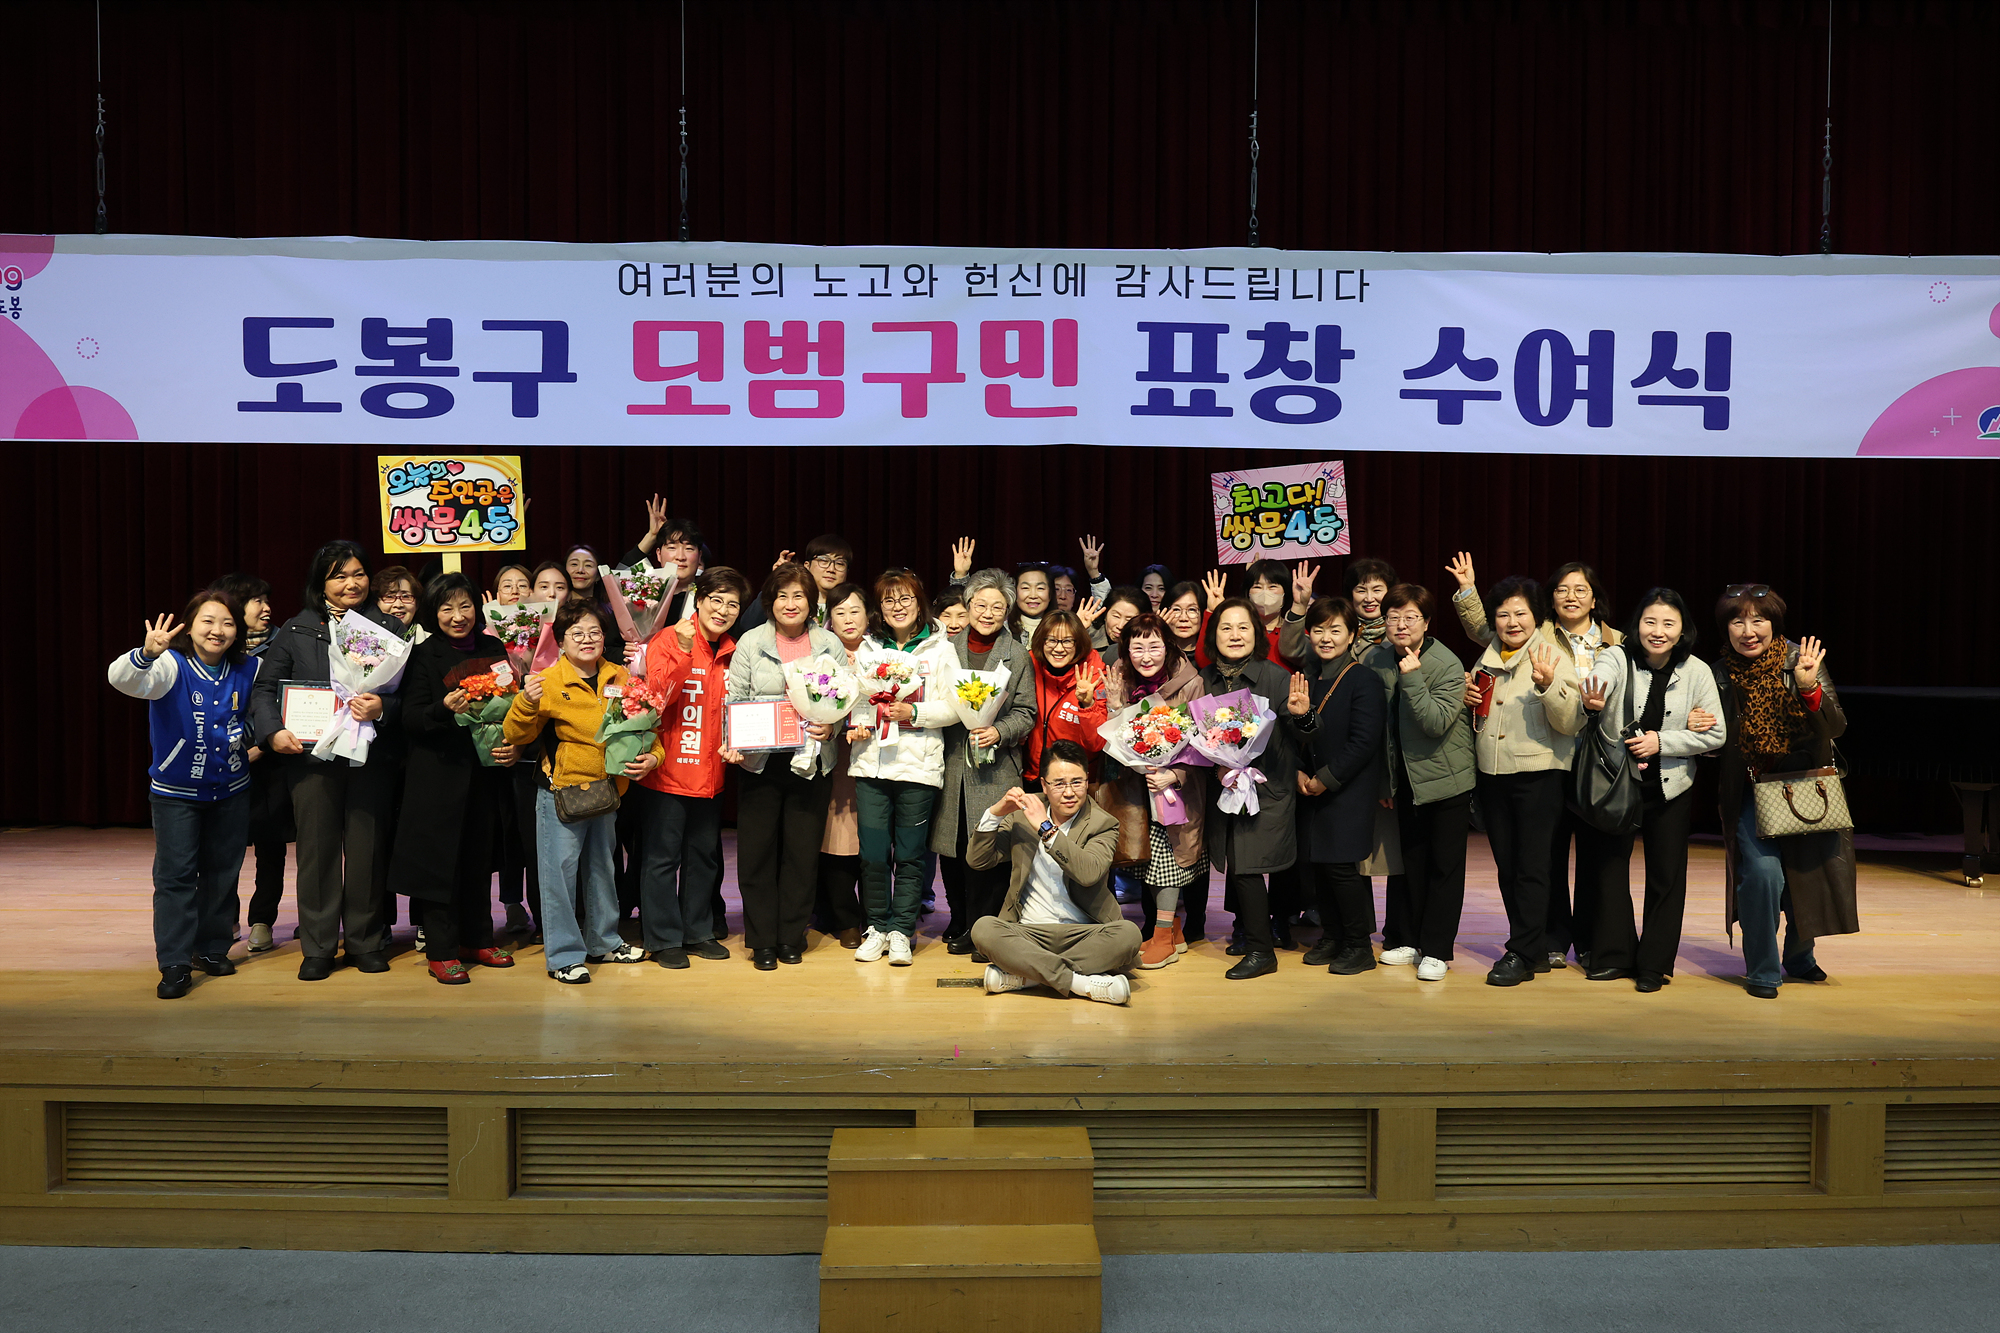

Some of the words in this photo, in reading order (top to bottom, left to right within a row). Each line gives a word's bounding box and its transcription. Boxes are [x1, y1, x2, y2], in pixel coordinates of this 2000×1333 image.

[618, 262, 784, 298] 여러분의
[813, 263, 939, 299] 노고와
[964, 262, 1086, 298] 헌신에
[1115, 264, 1370, 303] 감사드립니다
[237, 316, 578, 420] 도봉구
[626, 318, 1079, 419] 모범구민
[1130, 321, 1356, 425] 표창
[1399, 326, 1732, 431] 수여식
[388, 462, 448, 495] 오늘의
[428, 479, 515, 506] 주인공은
[1231, 478, 1326, 514] 최고다!
[390, 505, 518, 544] 쌍문4동
[1221, 505, 1344, 550] 쌍문4동
[231, 691, 239, 711] 1
[680, 679, 704, 755] 구의원
